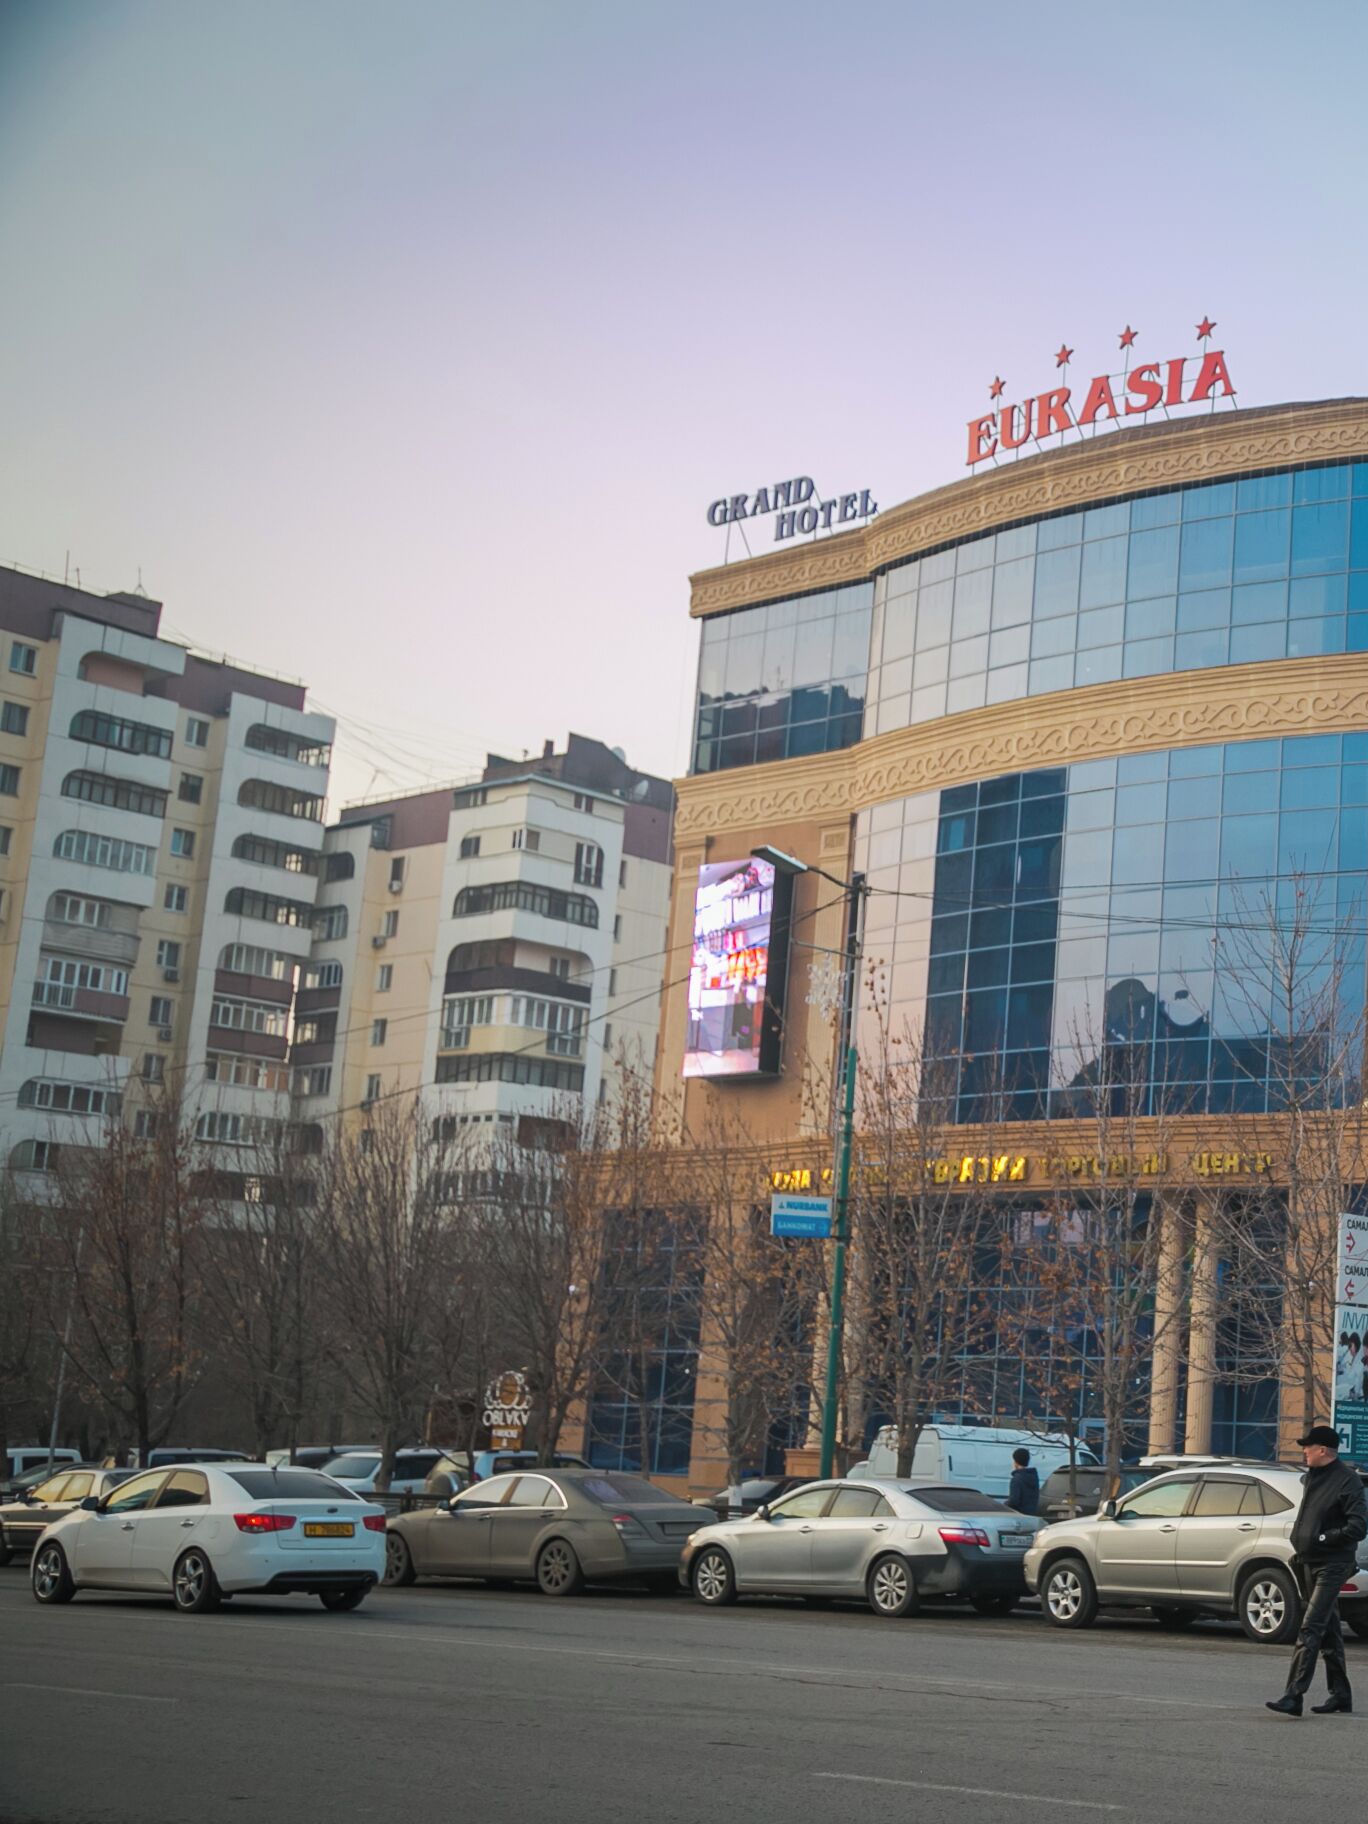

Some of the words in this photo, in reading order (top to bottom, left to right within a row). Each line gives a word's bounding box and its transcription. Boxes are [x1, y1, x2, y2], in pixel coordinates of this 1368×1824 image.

[966, 350, 1237, 466] EURASIA
[707, 475, 814, 526] GRAND
[774, 488, 877, 541] HOTEL
[786, 1202, 828, 1212] NURBANK
[1344, 1265, 1368, 1277] САМАЛ
